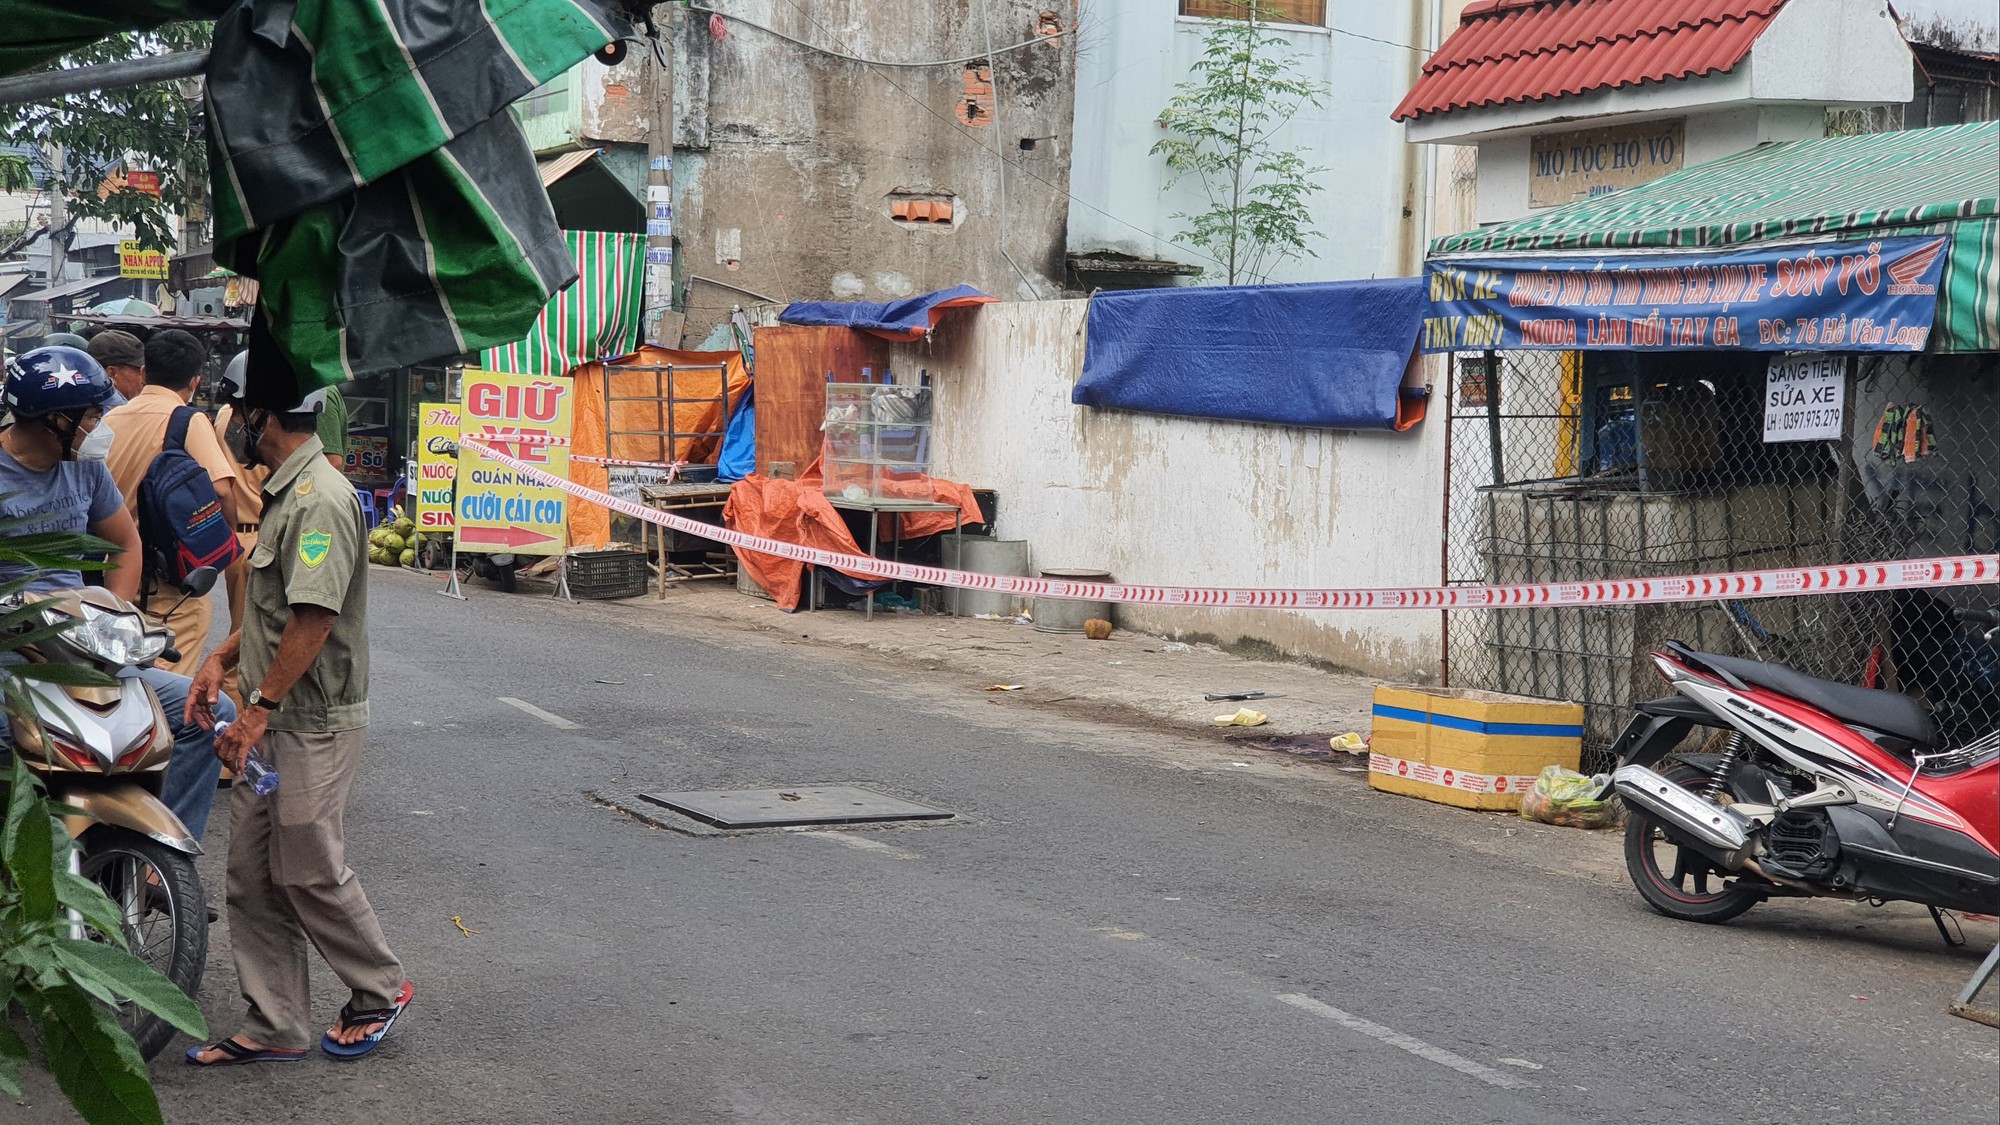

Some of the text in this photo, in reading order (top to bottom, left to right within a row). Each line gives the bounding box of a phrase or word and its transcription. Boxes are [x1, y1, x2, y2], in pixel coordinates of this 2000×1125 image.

[1536, 142, 1565, 182] MỘ
[1570, 138, 1607, 180] TỘC
[1612, 140, 1641, 175] HỌ
[1837, 241, 1882, 296] VÕ
[1887, 284, 1936, 296] HONDA
[1424, 315, 1462, 349] THAY
[1520, 318, 1577, 346] HONDA
[1587, 312, 1628, 346] LÀM
[1671, 317, 1709, 346] TAY
[1713, 316, 1741, 346] GA
[1758, 318, 1791, 345] ĐC:
[1796, 318, 1820, 344] 76
[1820, 313, 1847, 345] Hồ
[1851, 317, 1885, 344] Văn
[1885, 318, 1930, 350] Long
[1769, 362, 1809, 383] SANG
[468, 381, 566, 423] GIỮ
[1770, 384, 1836, 407] SỬA XE
[424, 410, 461, 426] Thu
[1783, 408, 1840, 430] 0397.975.279
[480, 425, 549, 463] XE
[361, 450, 384, 468] Số
[472, 468, 555, 490] QUÁN NHẠ
[422, 489, 453, 503] NƯỚ
[422, 511, 455, 526] SIN
[461, 491, 563, 524] CƯỜI CÁI COI
